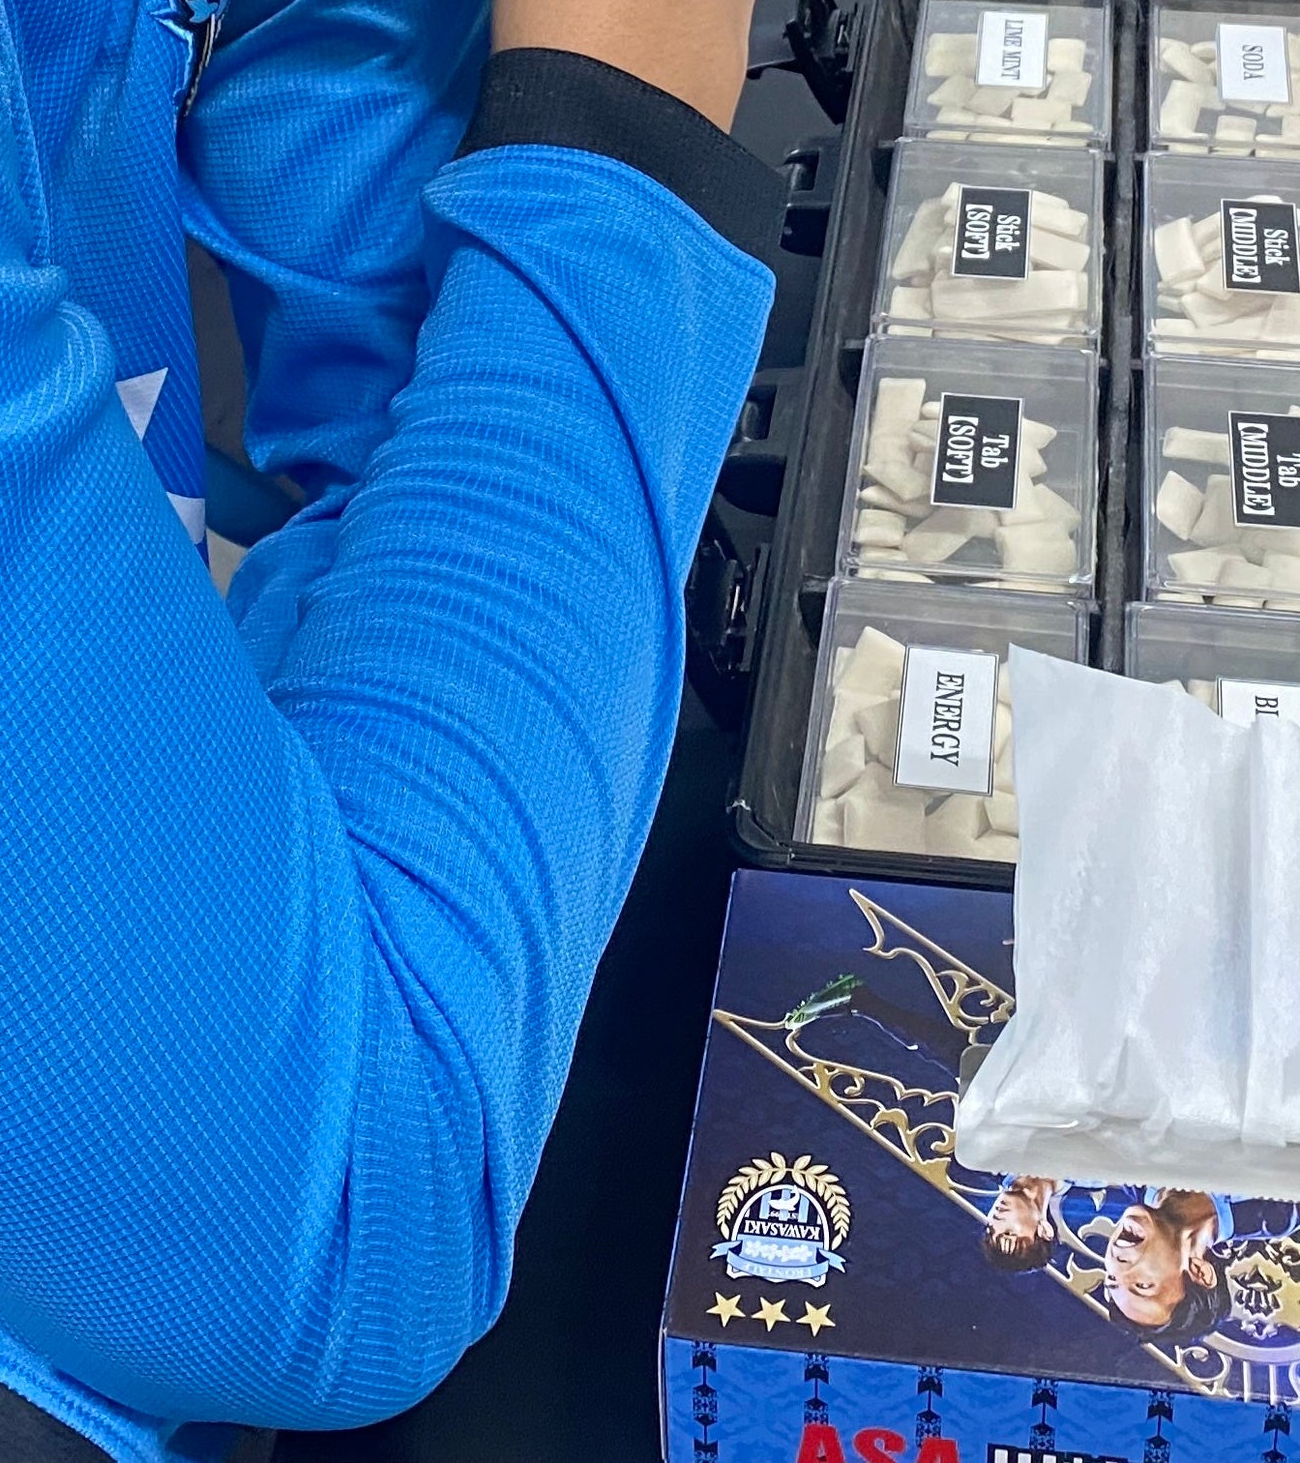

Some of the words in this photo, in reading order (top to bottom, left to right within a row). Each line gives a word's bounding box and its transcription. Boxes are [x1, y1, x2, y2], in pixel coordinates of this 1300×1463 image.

[1004, 19, 1022, 47] LIME
[1002, 51, 1022, 80] MINT
[1242, 45, 1264, 81] SODA
[997, 215, 1021, 252] Stick
[1263, 229, 1290, 268] Stick
[981, 435, 1008, 468] Tab
[930, 671, 965, 767] ENERGY
[744, 1220, 821, 1240] KAWASAKI
